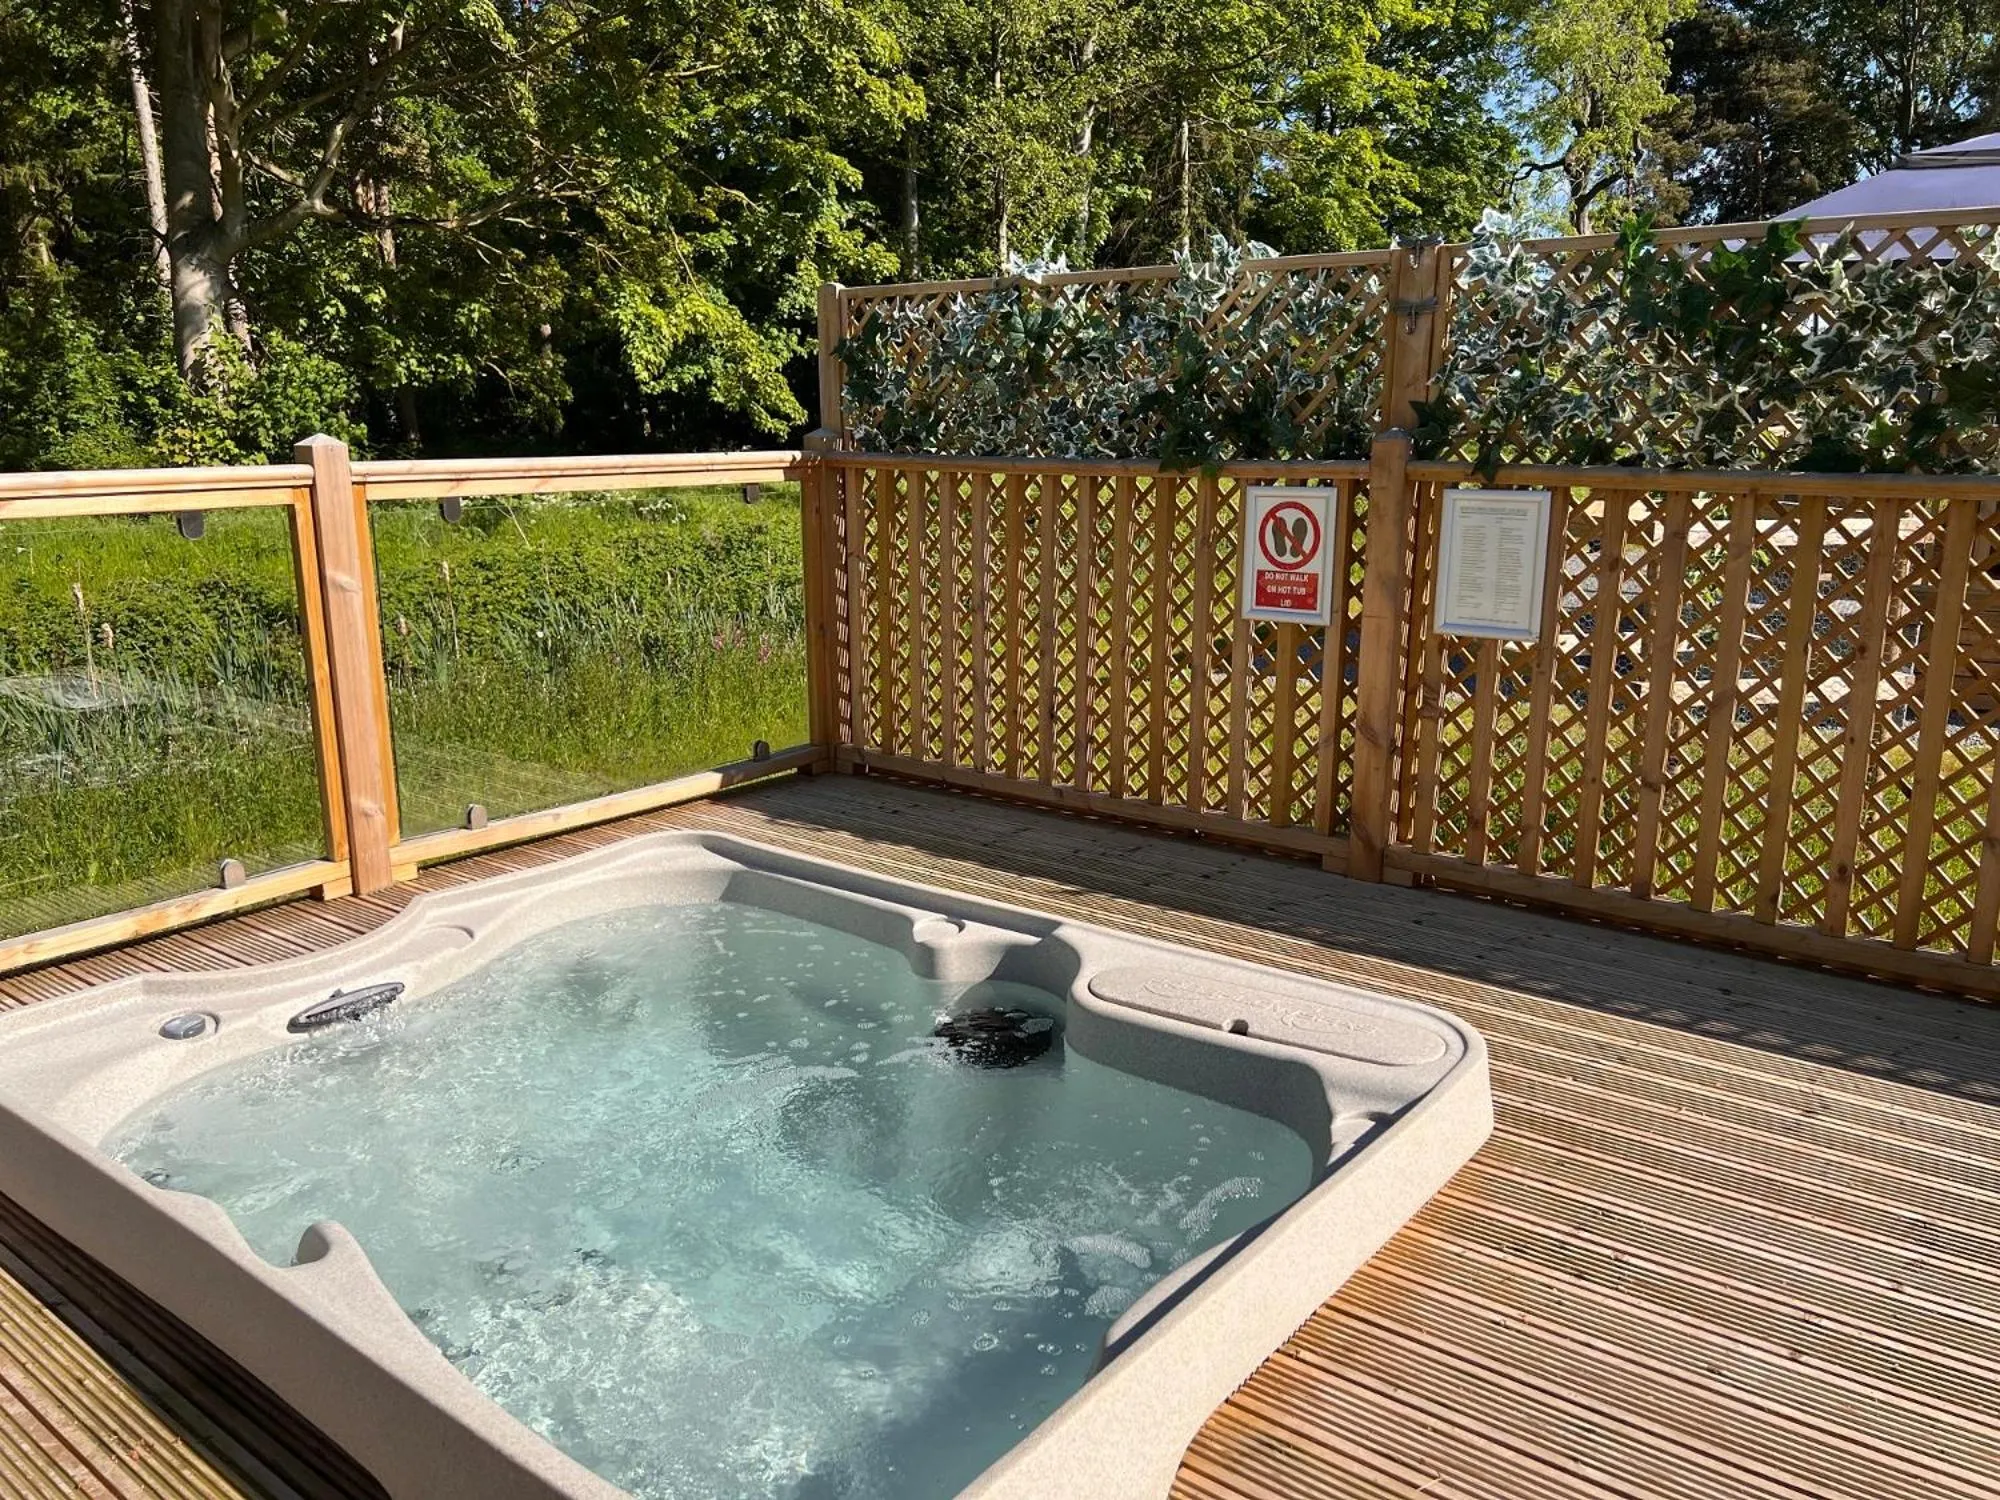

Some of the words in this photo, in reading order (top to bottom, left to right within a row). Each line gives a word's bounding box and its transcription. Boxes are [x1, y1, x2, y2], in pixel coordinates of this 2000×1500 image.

[1264, 572, 1274, 580] DO
[1276, 572, 1288, 581] NOT
[1290, 574, 1308, 583] WALK
[1266, 585, 1277, 593] ON
[1278, 586, 1291, 594] HOT
[1293, 586, 1306, 595] TUB
[1280, 599, 1292, 607] LID
